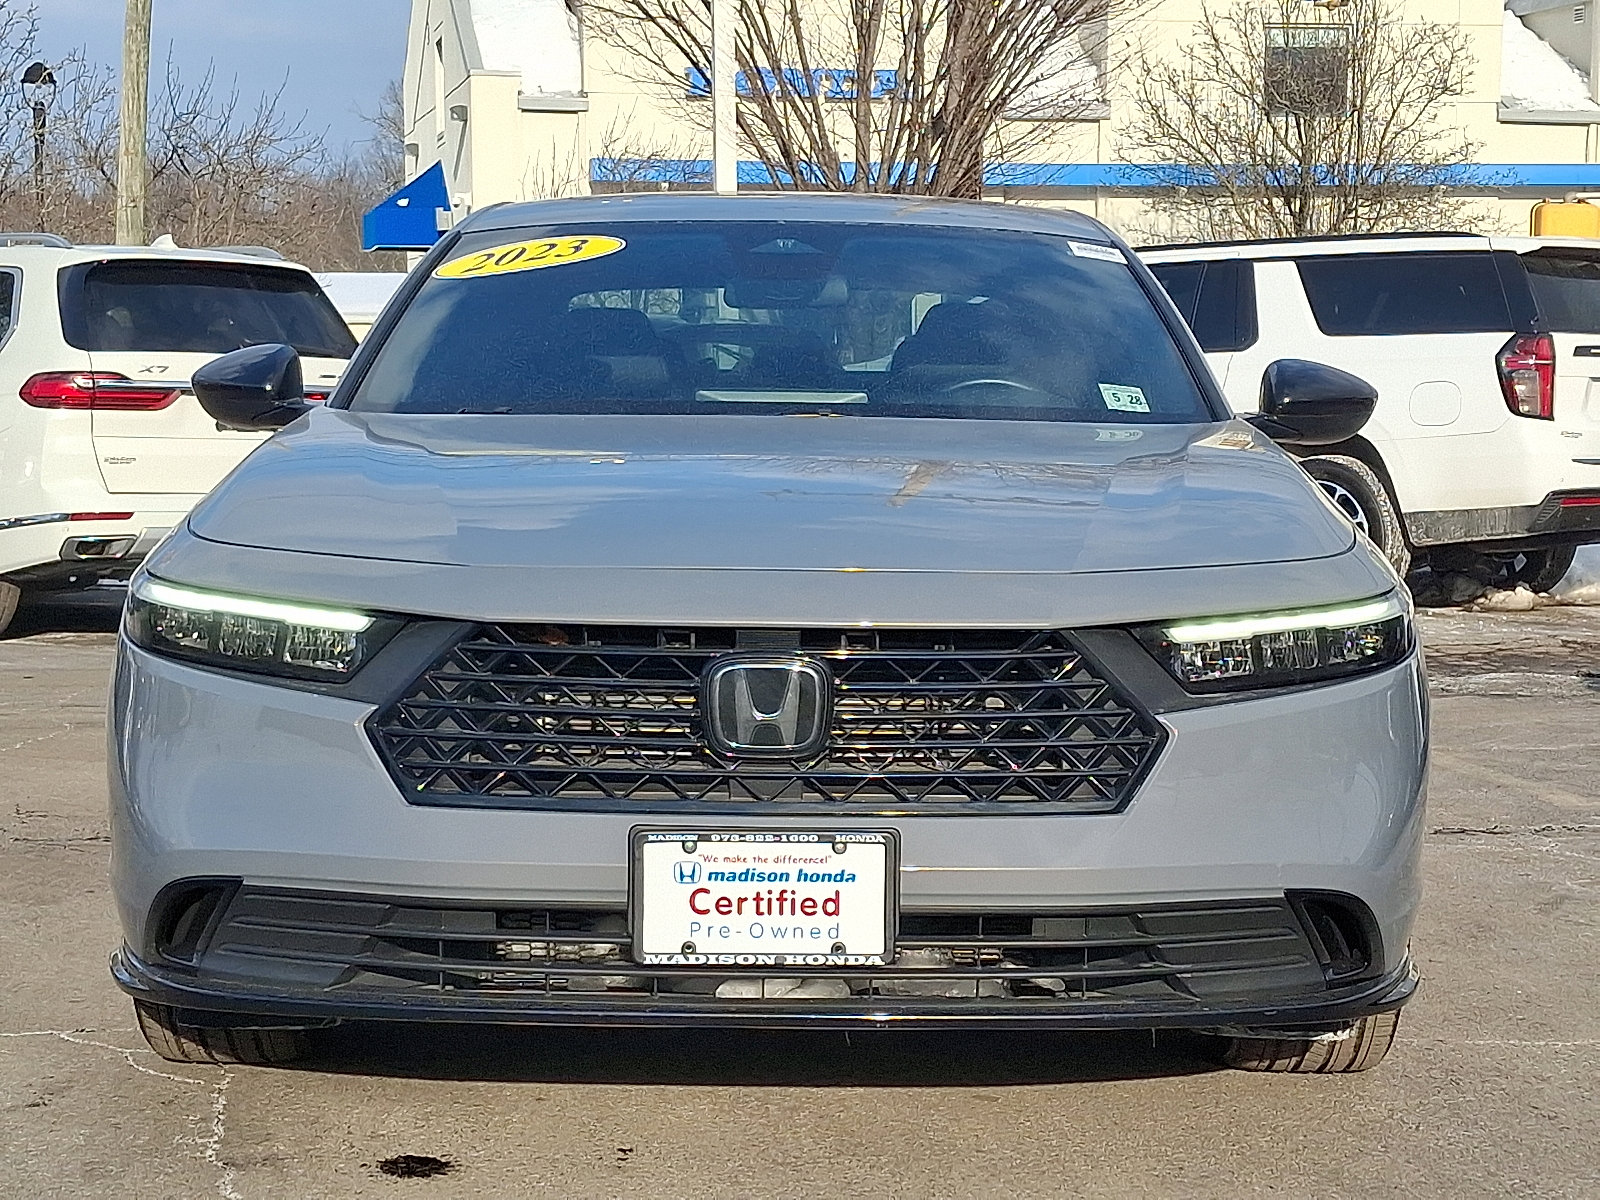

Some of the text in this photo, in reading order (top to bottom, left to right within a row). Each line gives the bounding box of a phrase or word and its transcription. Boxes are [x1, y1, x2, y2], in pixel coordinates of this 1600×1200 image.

[460, 239, 589, 274] 2023
[138, 365, 169, 373] X7
[1111, 392, 1143, 406] 5 28
[835, 834, 886, 843] HONDA
[723, 854, 748, 864] make
[752, 855, 769, 864] the
[707, 868, 790, 883] madison
[796, 869, 857, 883] honda
[689, 888, 840, 917] Certified
[690, 922, 840, 940] Pre-Owned
[643, 954, 886, 967] MADISON HONDA
